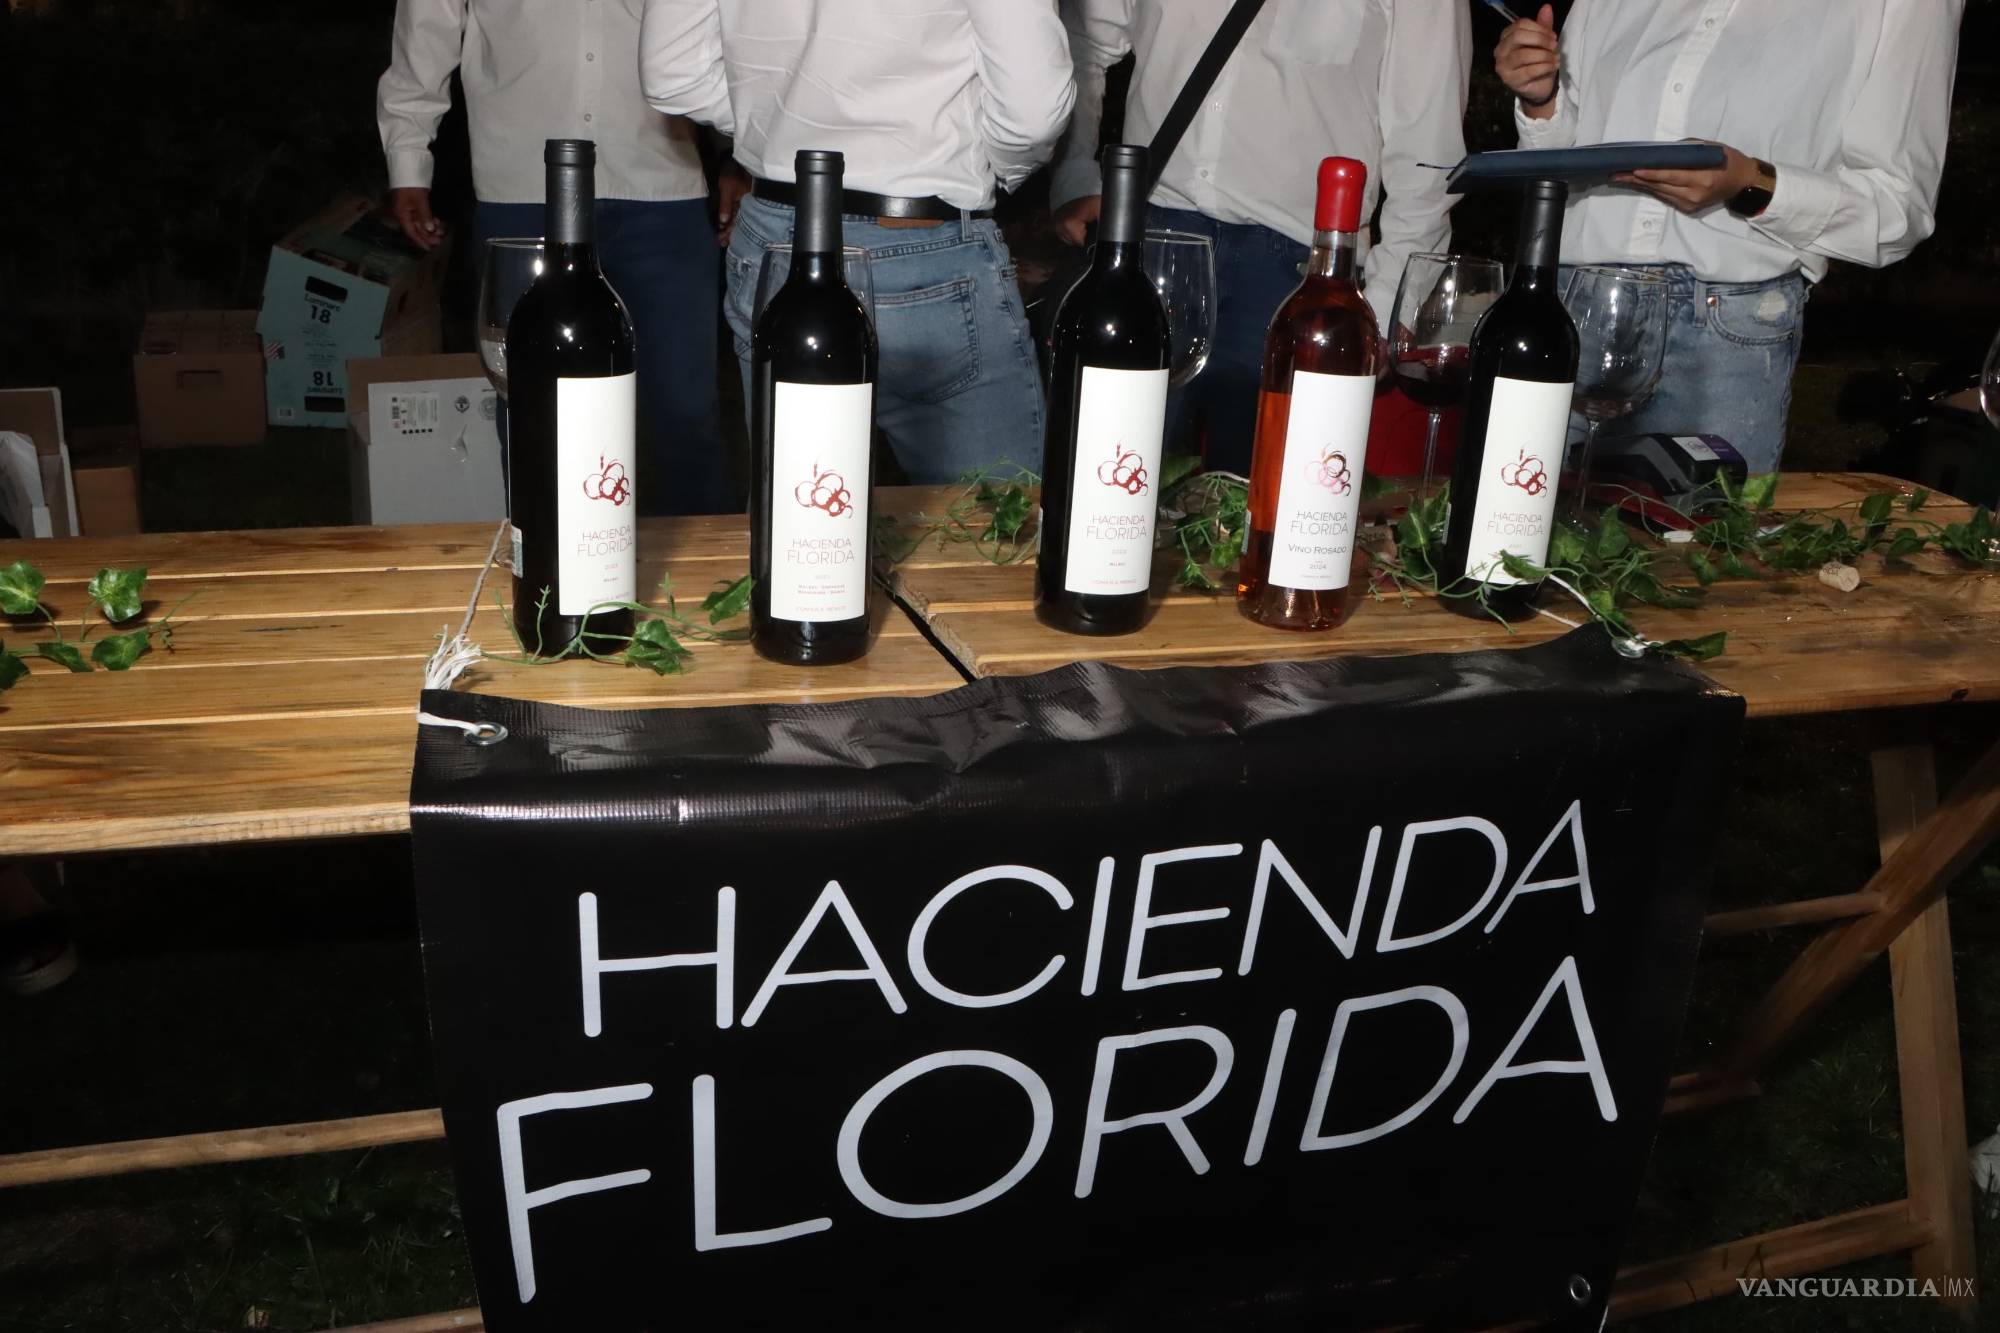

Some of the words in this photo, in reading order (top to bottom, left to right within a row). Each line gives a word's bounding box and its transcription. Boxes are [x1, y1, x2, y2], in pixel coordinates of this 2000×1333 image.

[311, 305, 331, 324] 18
[313, 371, 334, 386] 18
[1092, 514, 1145, 525] HACIENDA
[1296, 510, 1347, 521] HACIENDA
[1493, 512, 1542, 523] HACIENDA
[582, 524, 631, 541] HACIENDA
[1086, 526, 1147, 540] FLORIDA
[1290, 520, 1349, 536] FLORIDA
[1487, 520, 1544, 536] FLORIDA
[577, 535, 633, 557] FLORIDA
[792, 538, 852, 550] HACIENDA
[787, 550, 855, 565] FLORIDA
[578, 799, 1596, 1037] HACIENDA
[496, 955, 1618, 1303] FLORIDA
